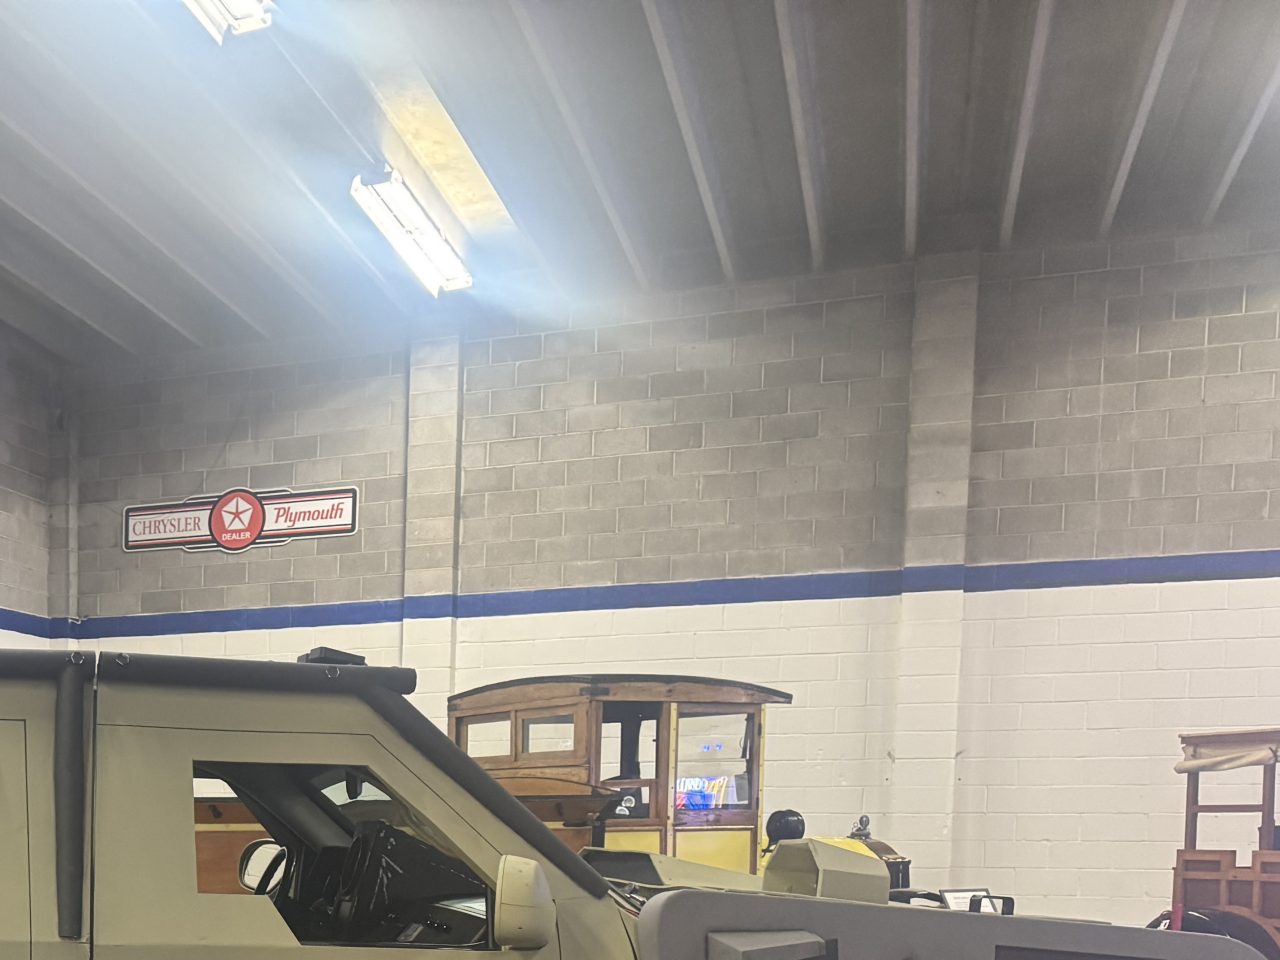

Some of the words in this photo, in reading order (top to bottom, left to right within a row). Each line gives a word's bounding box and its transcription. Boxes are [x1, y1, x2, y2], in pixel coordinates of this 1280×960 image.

[274, 501, 345, 528] Plymouth
[132, 516, 201, 536] CHRYSLER
[221, 531, 252, 542] DEALER
